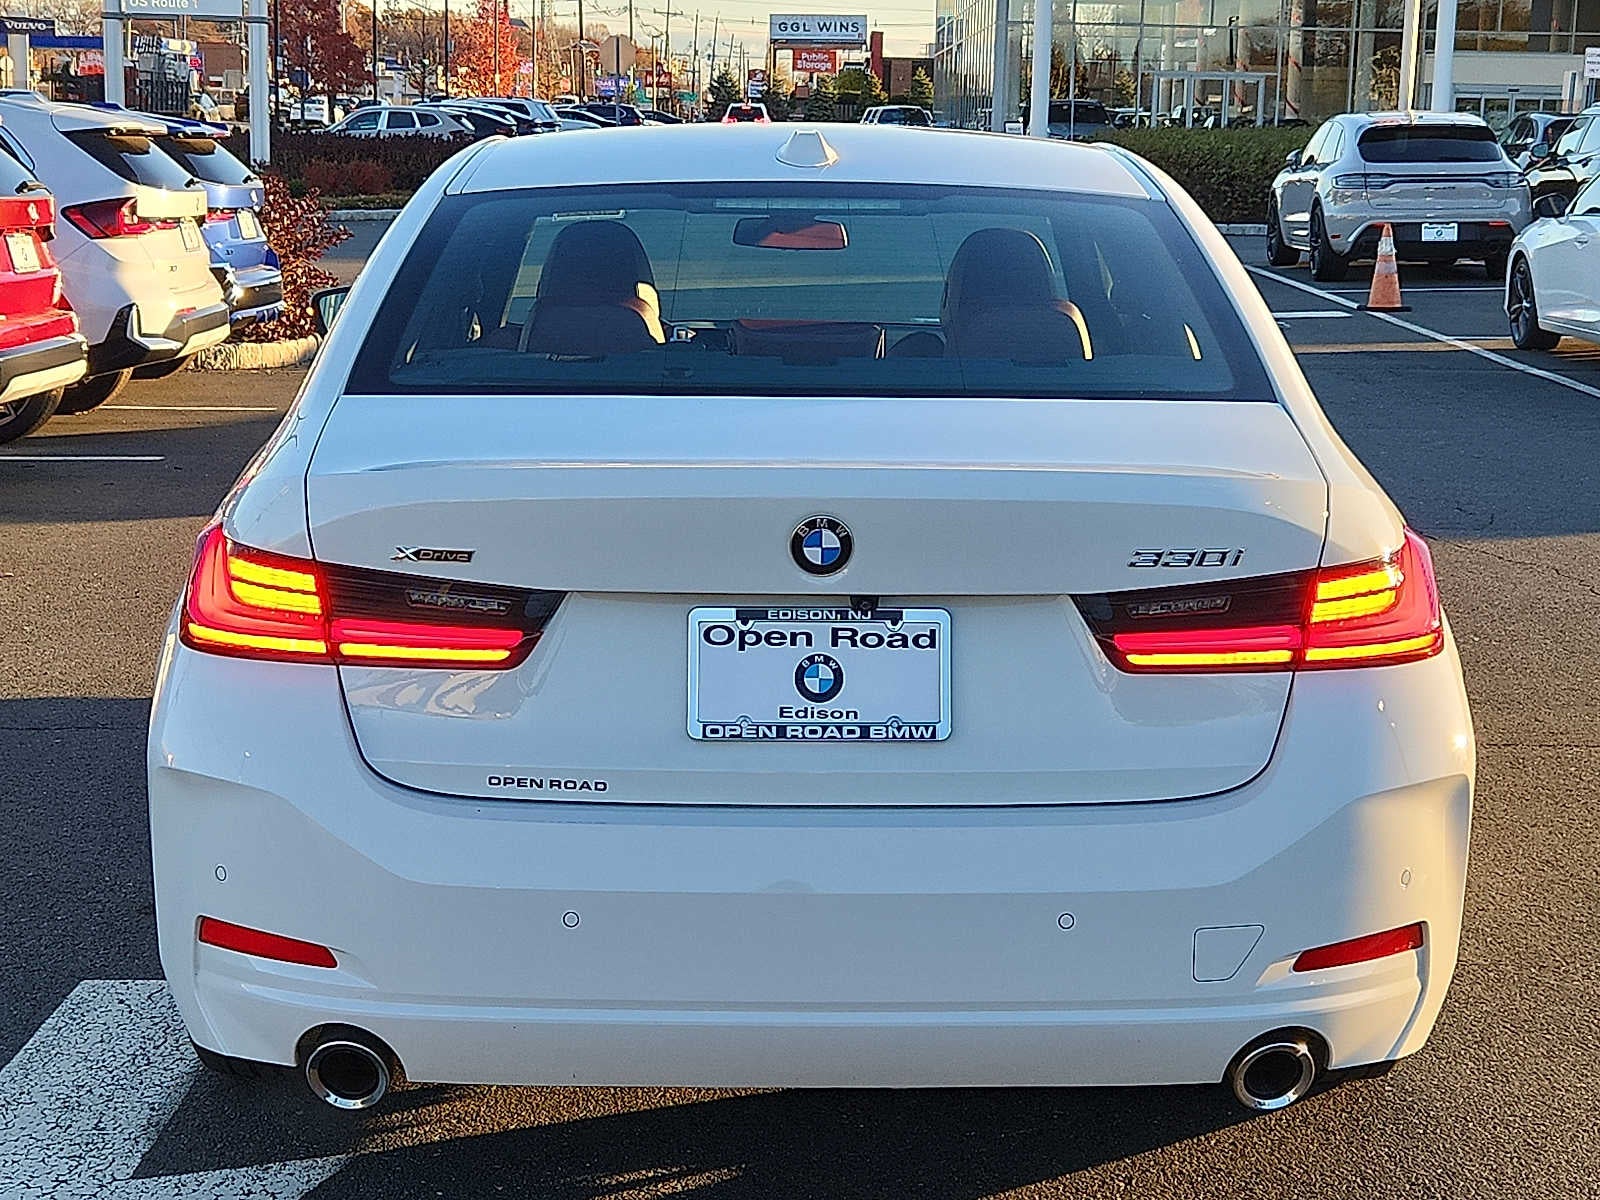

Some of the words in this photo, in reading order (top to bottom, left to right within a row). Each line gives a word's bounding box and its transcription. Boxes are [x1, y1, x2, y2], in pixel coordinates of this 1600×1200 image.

[152, 0, 189, 8] Route
[5, 21, 47, 30] VOLVO
[778, 22, 811, 32] GGL
[817, 21, 860, 32] WINS
[801, 52, 829, 61] Public
[797, 60, 832, 71] Storage
[797, 518, 848, 538] BMW
[1127, 547, 1247, 568] 330i
[768, 610, 841, 621] EDISON,
[848, 611, 872, 621] NJ
[703, 624, 813, 651] Open
[830, 627, 938, 649] Road
[779, 707, 859, 720] Edison
[705, 725, 777, 738] OPEN
[786, 726, 860, 738] ROAD
[869, 726, 934, 738] BMW
[488, 776, 544, 788] OPEN
[549, 779, 608, 791] ROAD
